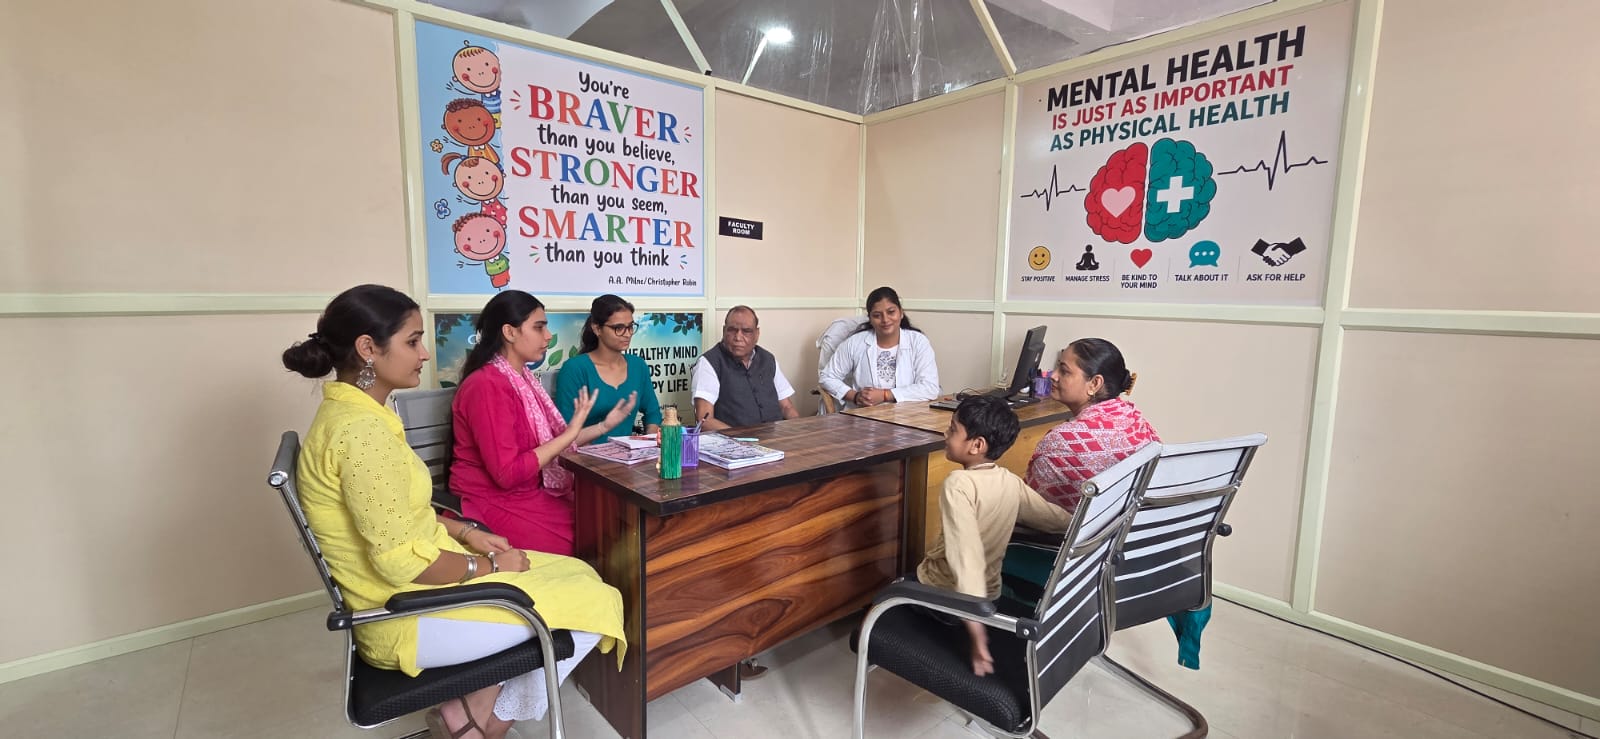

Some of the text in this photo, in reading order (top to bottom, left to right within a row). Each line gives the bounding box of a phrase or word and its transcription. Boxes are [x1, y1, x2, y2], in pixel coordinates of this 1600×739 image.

[1047, 25, 1306, 112] MENTAL HEALTH
[578, 71, 630, 99] You're
[1052, 64, 1294, 130] IS JUST AS IMPORTANT
[528, 84, 680, 144] BRAVER
[1050, 91, 1290, 152] AS PHYSICAL HEALTH
[537, 124, 676, 166] than you believe,
[510, 146, 701, 199] STRONGER
[551, 184, 668, 215] than you seem,
[519, 206, 695, 248] SMARTER
[728, 221, 755, 230] FACULTY
[732, 227, 750, 235] ROOM
[545, 242, 670, 269] than you think
[608, 276, 623, 285] A.A.
[682, 278, 697, 287] Robin
[1120, 281, 1158, 289] YOUR MIND
[1148, 273, 1158, 281] TO
[1175, 273, 1229, 282] TALK ABOUT IT
[1246, 273, 1306, 281] ASK FOR HELP
[673, 345, 698, 360] MIND
[663, 363, 677, 377] TO
[679, 362, 687, 375] A
[667, 378, 689, 393] LIFE
